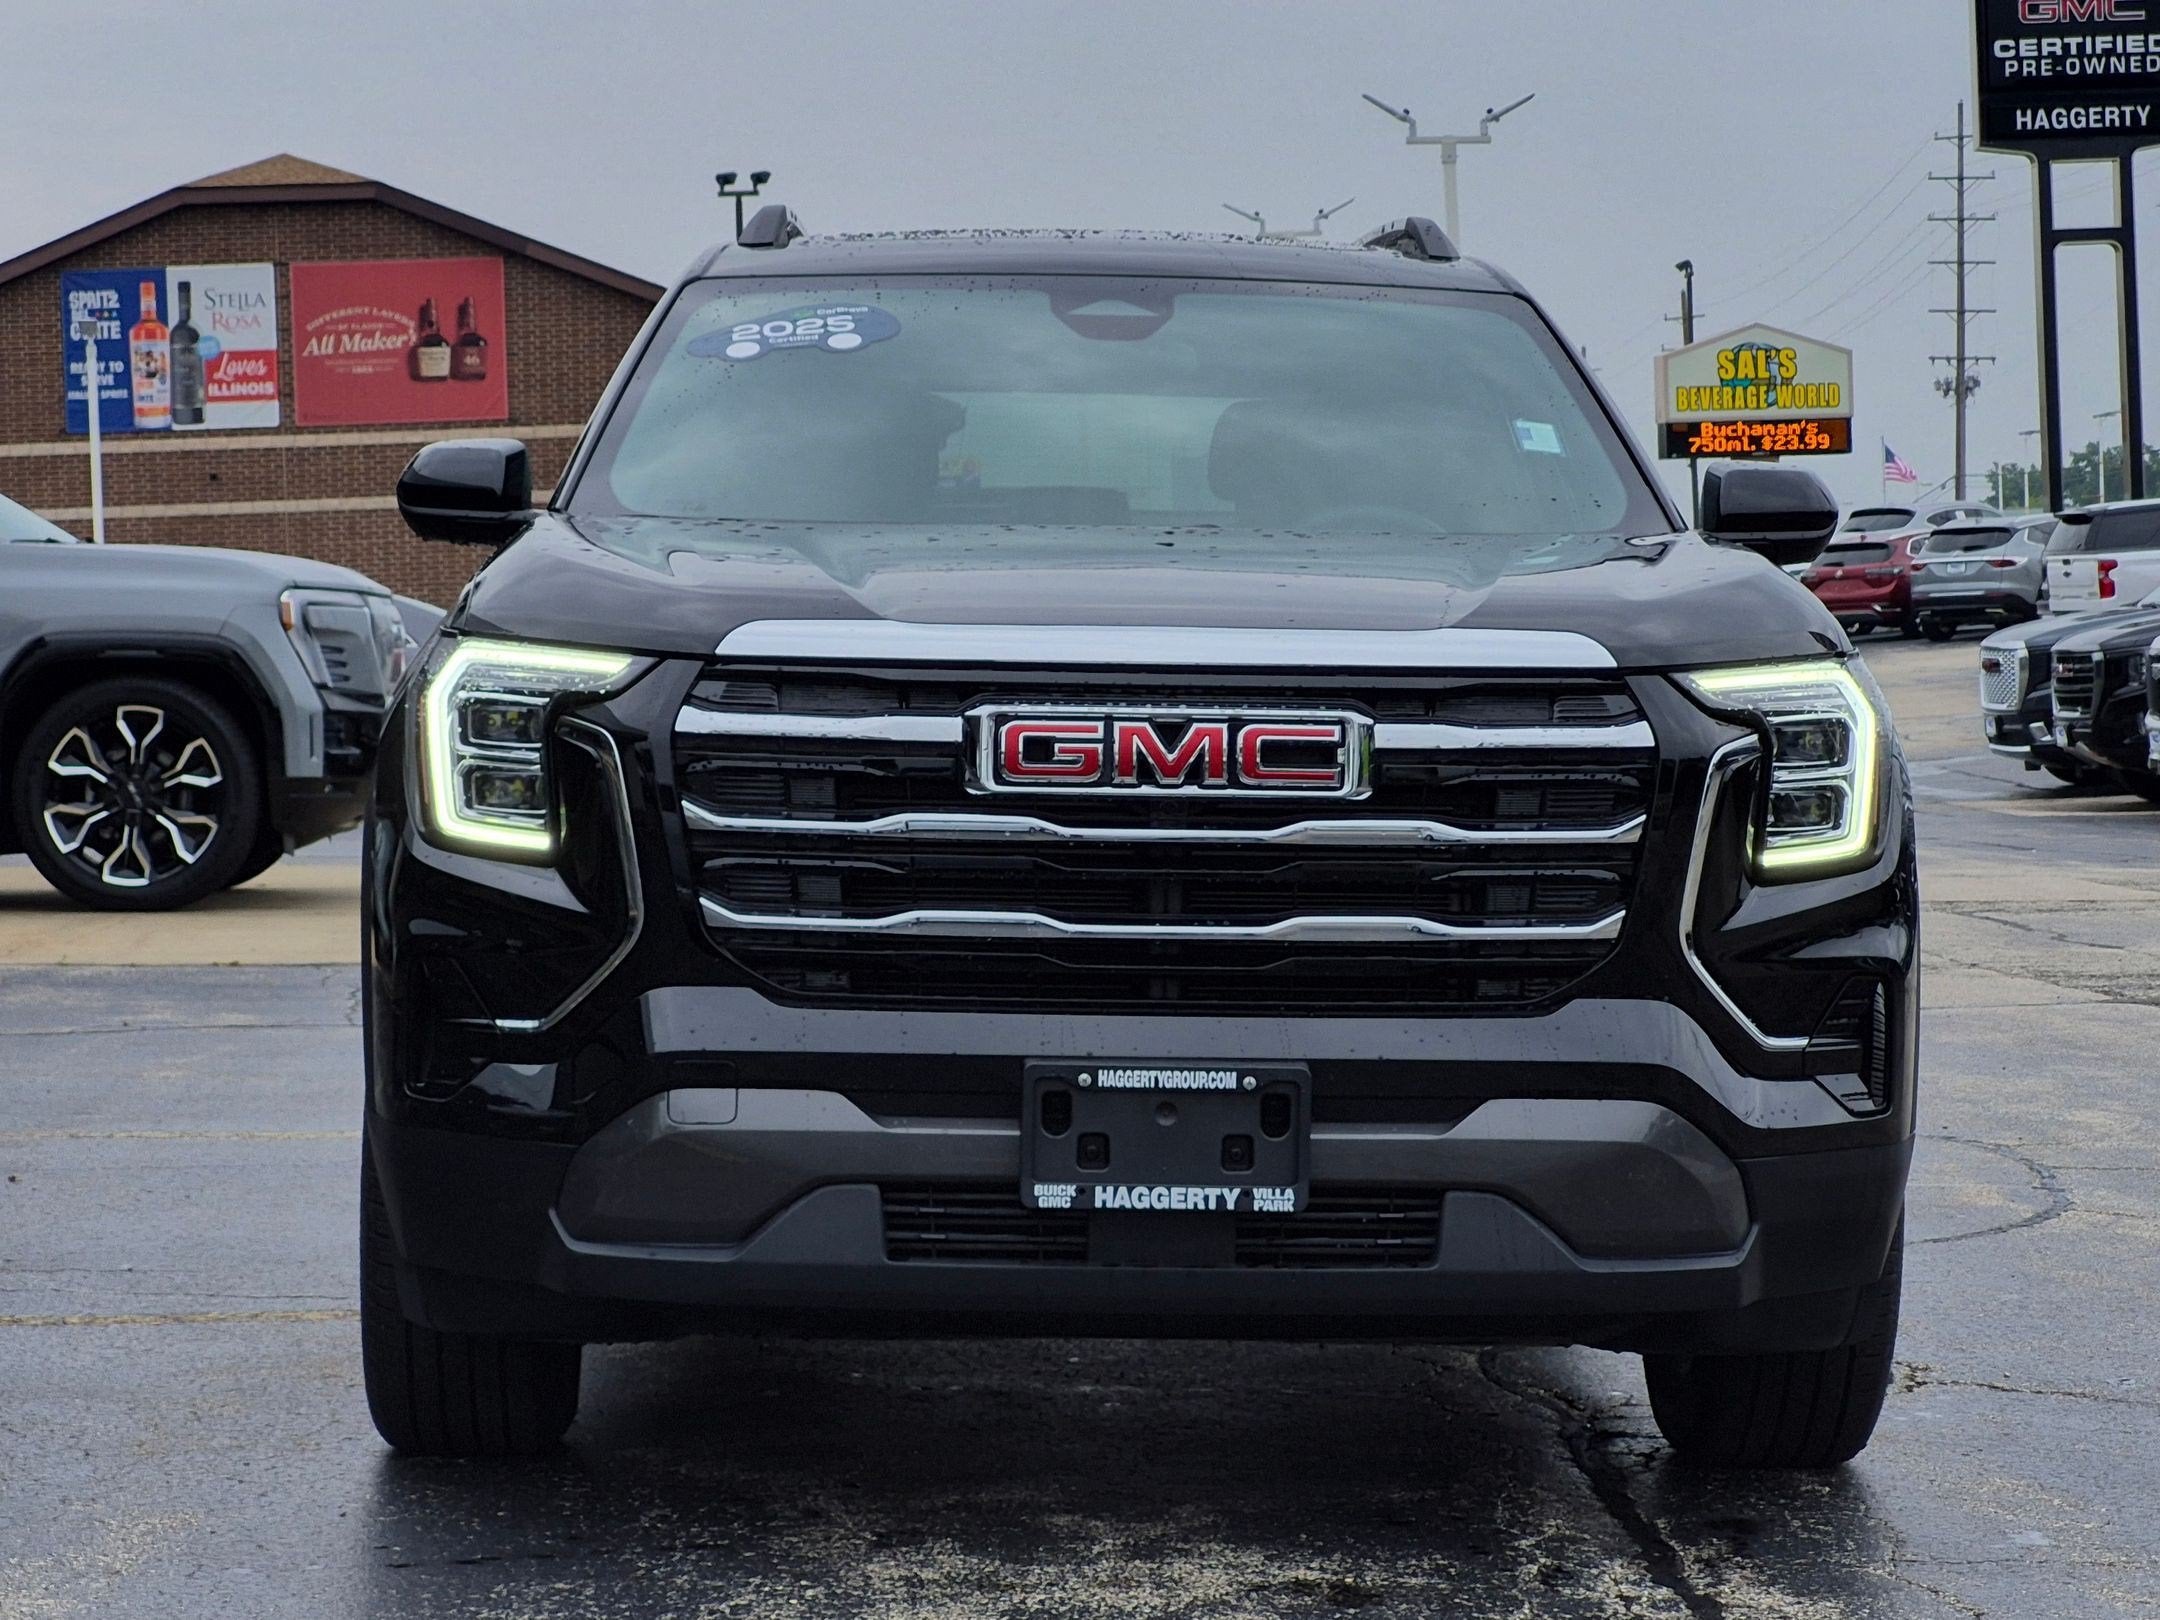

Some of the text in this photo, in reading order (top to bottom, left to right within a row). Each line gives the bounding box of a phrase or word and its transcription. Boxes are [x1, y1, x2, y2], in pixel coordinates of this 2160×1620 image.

[2018, 0, 2145, 23] GMC
[2005, 55, 2160, 77] PRE-OWNED
[2016, 105, 2151, 130] HAGGERTY
[68, 289, 121, 309] SPRITZ
[204, 288, 266, 311] STELLA
[70, 321, 122, 341] CTE
[212, 311, 262, 334] ROSA
[731, 315, 856, 341] 2025
[302, 330, 417, 357] All Maker's
[768, 335, 819, 344] Certified
[108, 360, 125, 373] TO
[212, 351, 267, 381] Loves
[1717, 347, 1798, 381] SAL'S
[208, 382, 274, 397] ILLINOIS
[1676, 382, 1841, 412] BEVERAGE WORLD
[1700, 419, 1819, 438] Buchanan's
[1688, 433, 1830, 453] 750ml. $23.99
[1000, 720, 1341, 786] GMC
[1097, 1069, 1237, 1090] HAGGERTYGROUP.COM
[1034, 1184, 1077, 1198] BUICK
[1094, 1186, 1241, 1211] HAGGERTY
[1252, 1188, 1295, 1200] VILLA
[1038, 1197, 1071, 1209] GMC
[1253, 1199, 1294, 1212] PARK
